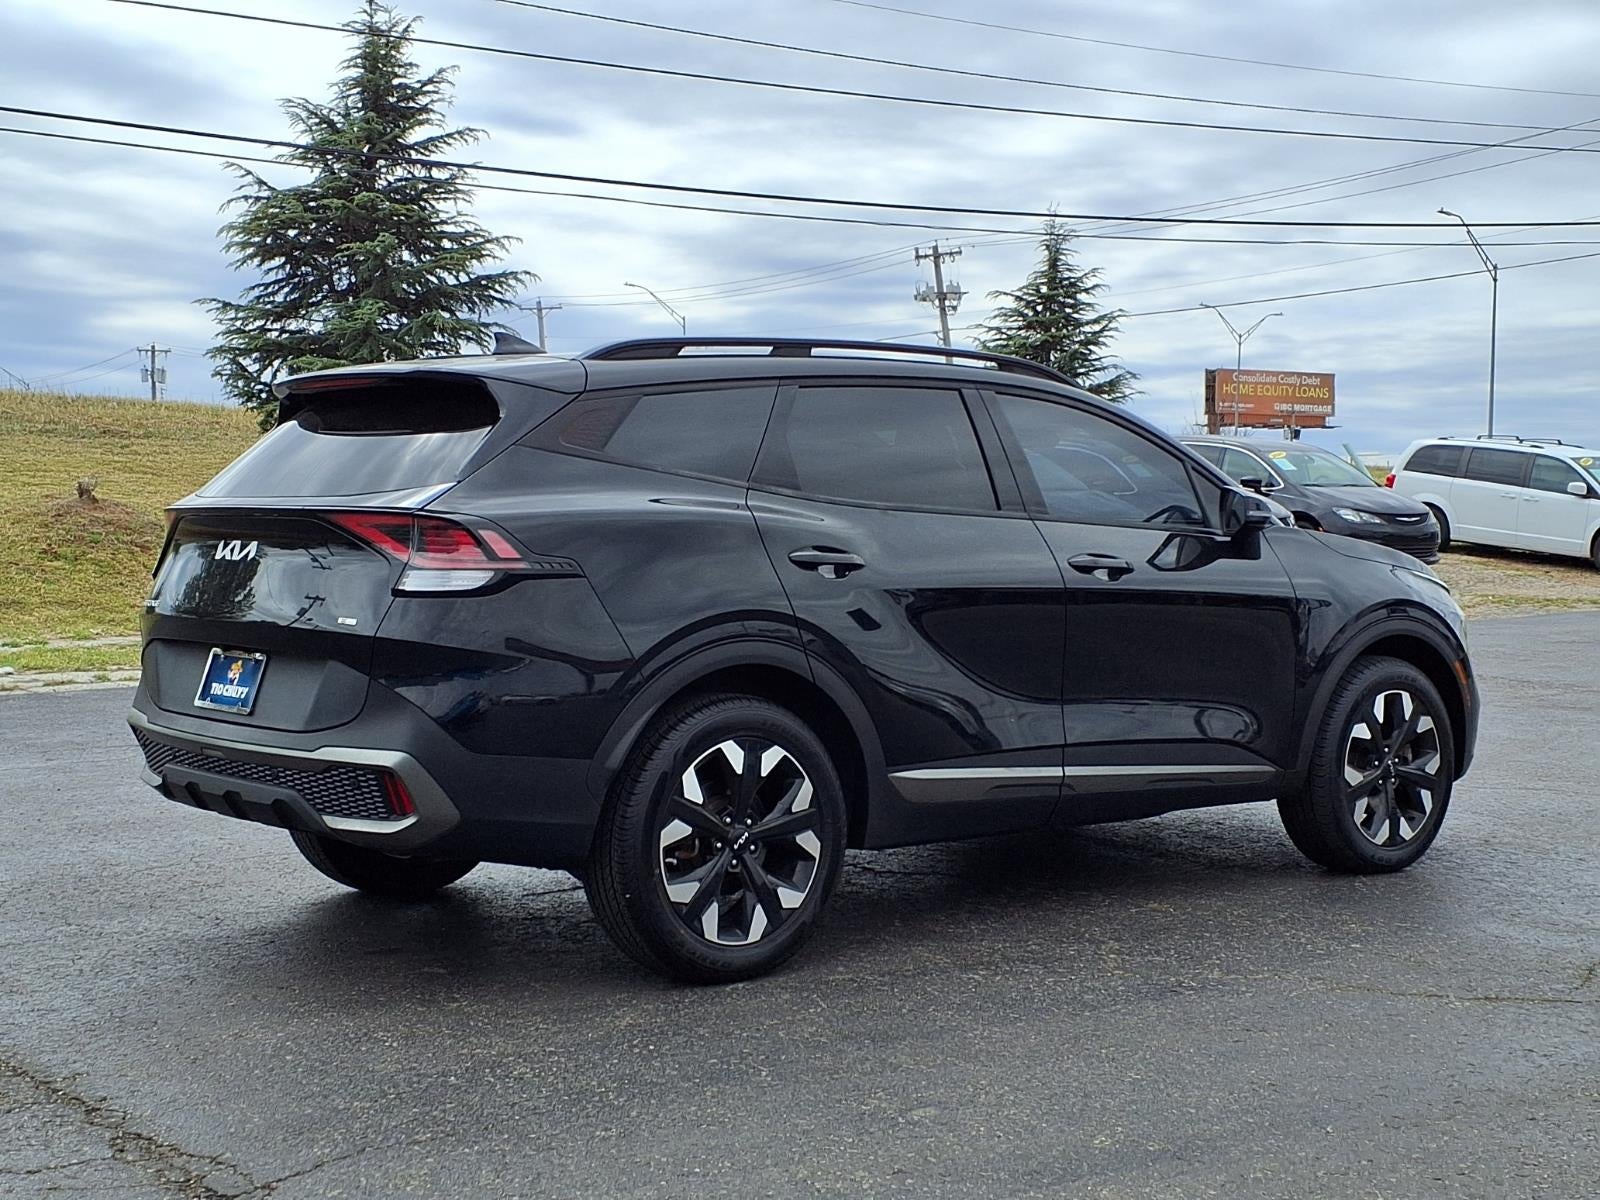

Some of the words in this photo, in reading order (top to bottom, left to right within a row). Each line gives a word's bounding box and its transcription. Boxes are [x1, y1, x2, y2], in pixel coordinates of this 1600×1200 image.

[1232, 372, 1277, 383] Consolidate
[1278, 374, 1301, 386] Costly
[1301, 376, 1321, 386] Debt
[1222, 383, 1255, 395] HOME
[1257, 384, 1294, 397] EQUITY
[1295, 386, 1329, 399] LOANS
[1293, 403, 1332, 413] MORTGAGE
[214, 539, 258, 561] KIA
